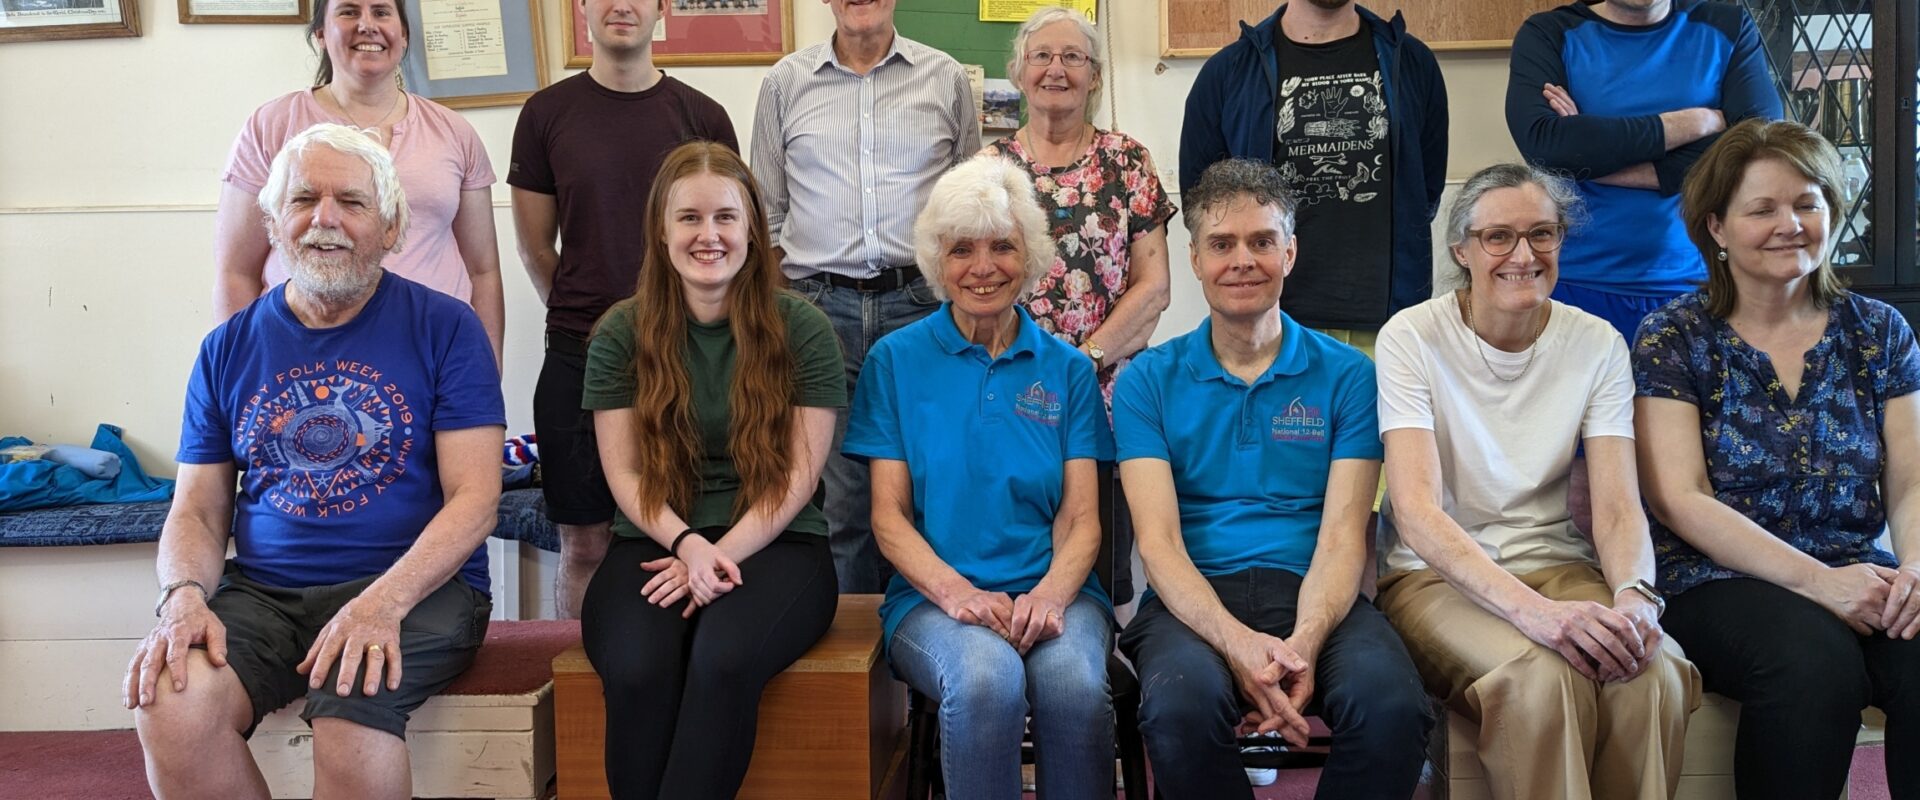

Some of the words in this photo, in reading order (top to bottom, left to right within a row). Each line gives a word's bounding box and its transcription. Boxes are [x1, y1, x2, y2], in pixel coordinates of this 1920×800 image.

[1288, 140, 1374, 157] MERMAIDENS
[276, 361, 326, 385] FOLK
[335, 360, 383, 382] WEEK
[236, 383, 270, 446] WHITBY
[383, 383, 413, 424] 2019
[1272, 416, 1325, 427] SHEFFIELD
[375, 438, 414, 495] WHITBY
[269, 490, 306, 518] WEEK
[317, 493, 369, 518] FOLK
